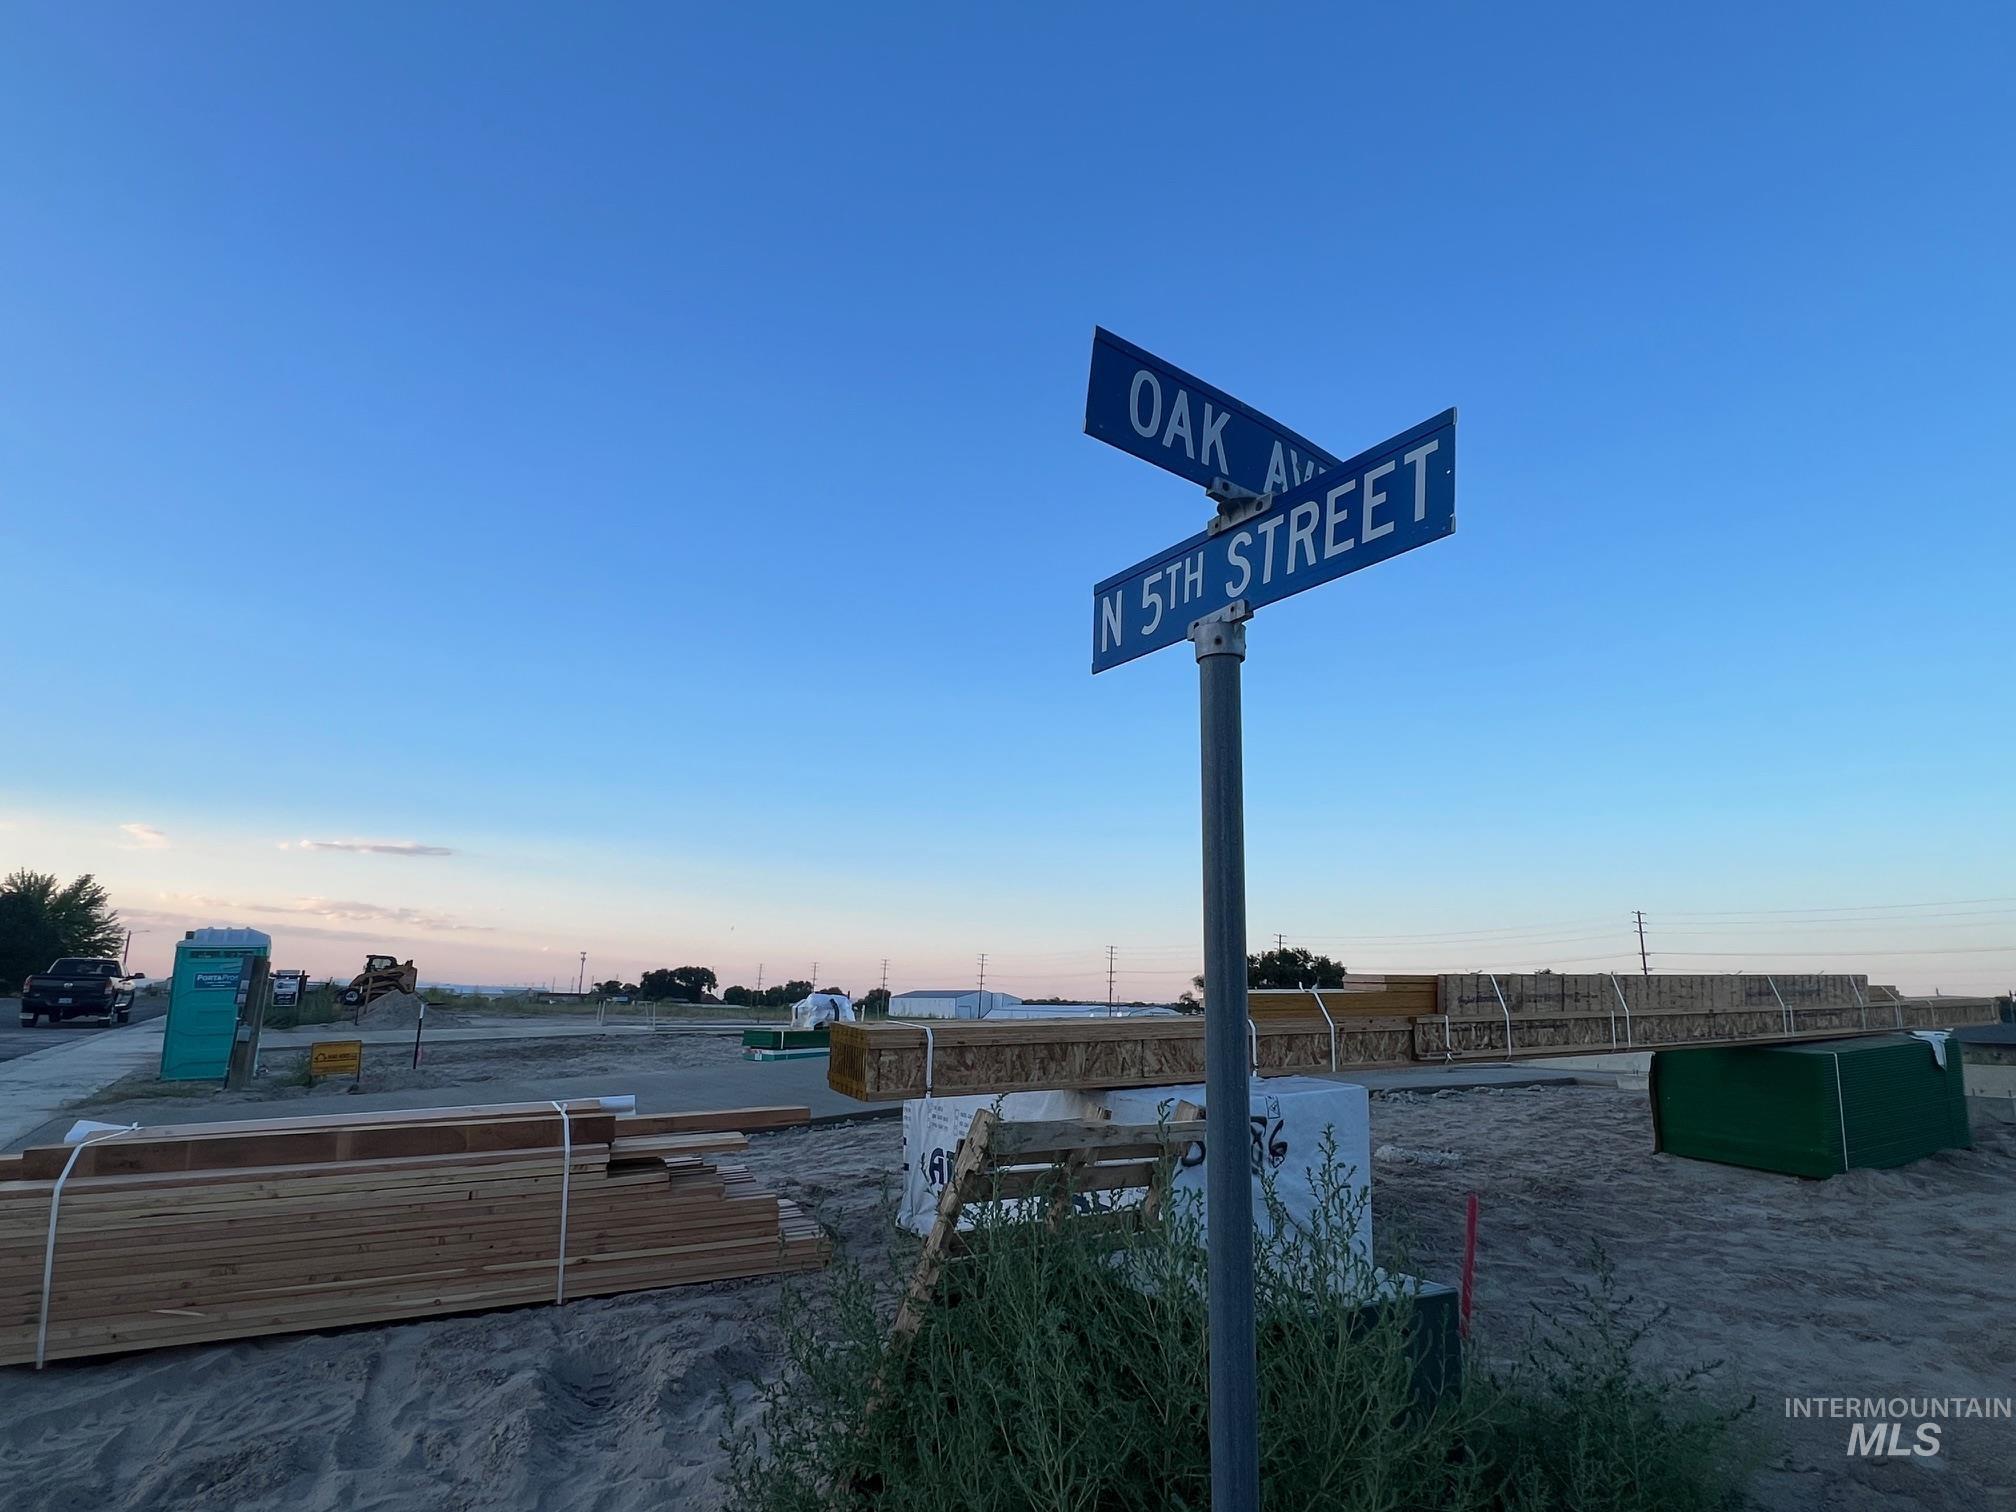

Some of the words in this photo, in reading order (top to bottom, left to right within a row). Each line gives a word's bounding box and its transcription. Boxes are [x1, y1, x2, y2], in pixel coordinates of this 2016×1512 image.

[1129, 369, 1231, 475] OAK
[1262, 440, 1327, 494] AV
[1101, 590, 1122, 653] N
[1141, 551, 1204, 636] 5TH
[1225, 439, 1439, 598] STREET
